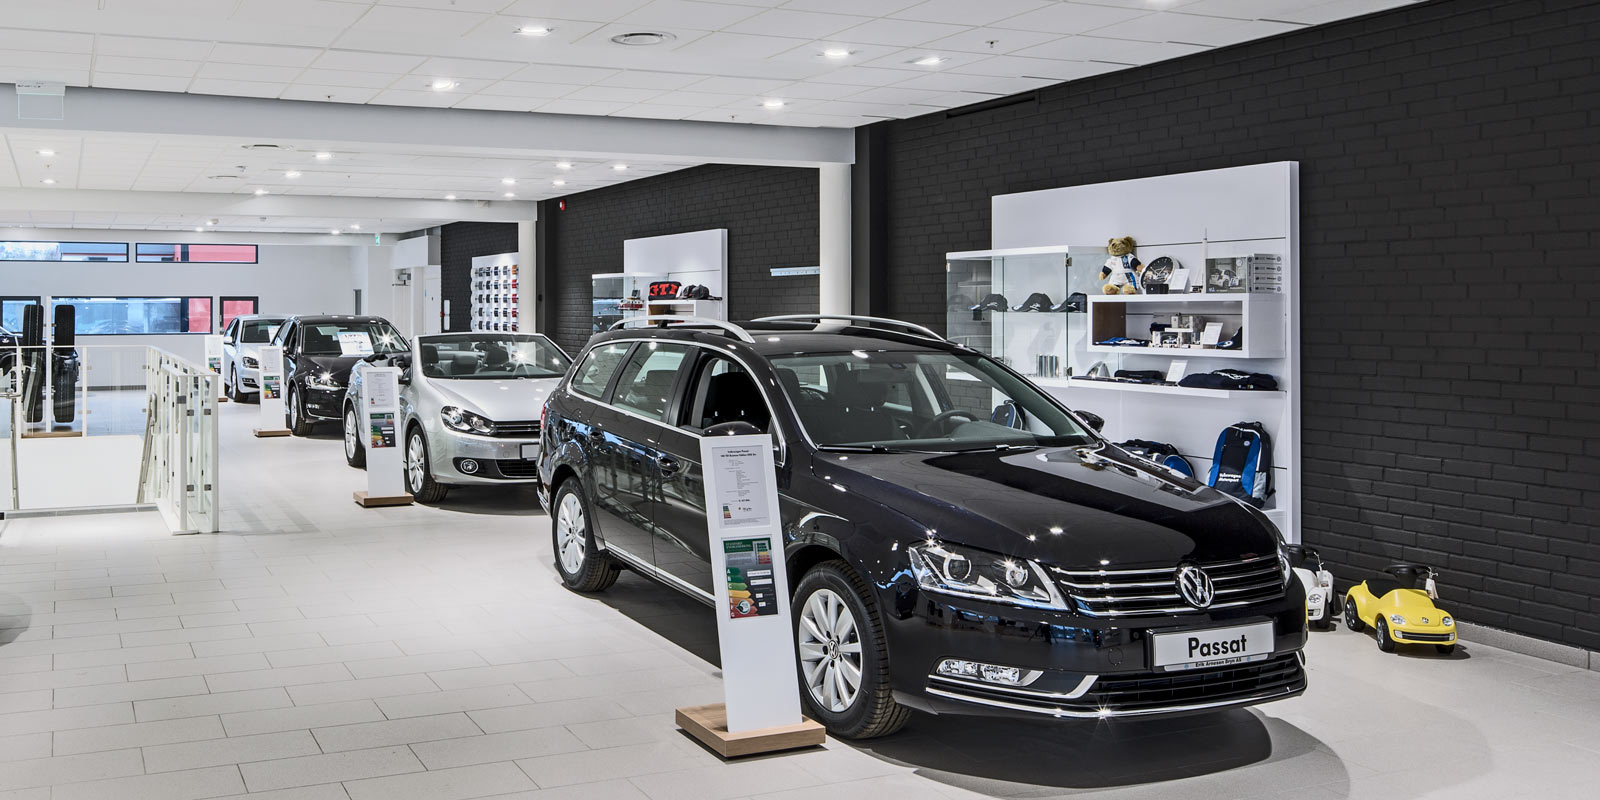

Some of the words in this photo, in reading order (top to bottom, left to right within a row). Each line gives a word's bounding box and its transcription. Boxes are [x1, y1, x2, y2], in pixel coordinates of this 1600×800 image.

[649, 283, 678, 296] GTI
[1188, 634, 1247, 658] Passat
[1206, 659, 1225, 667] Arnesen
